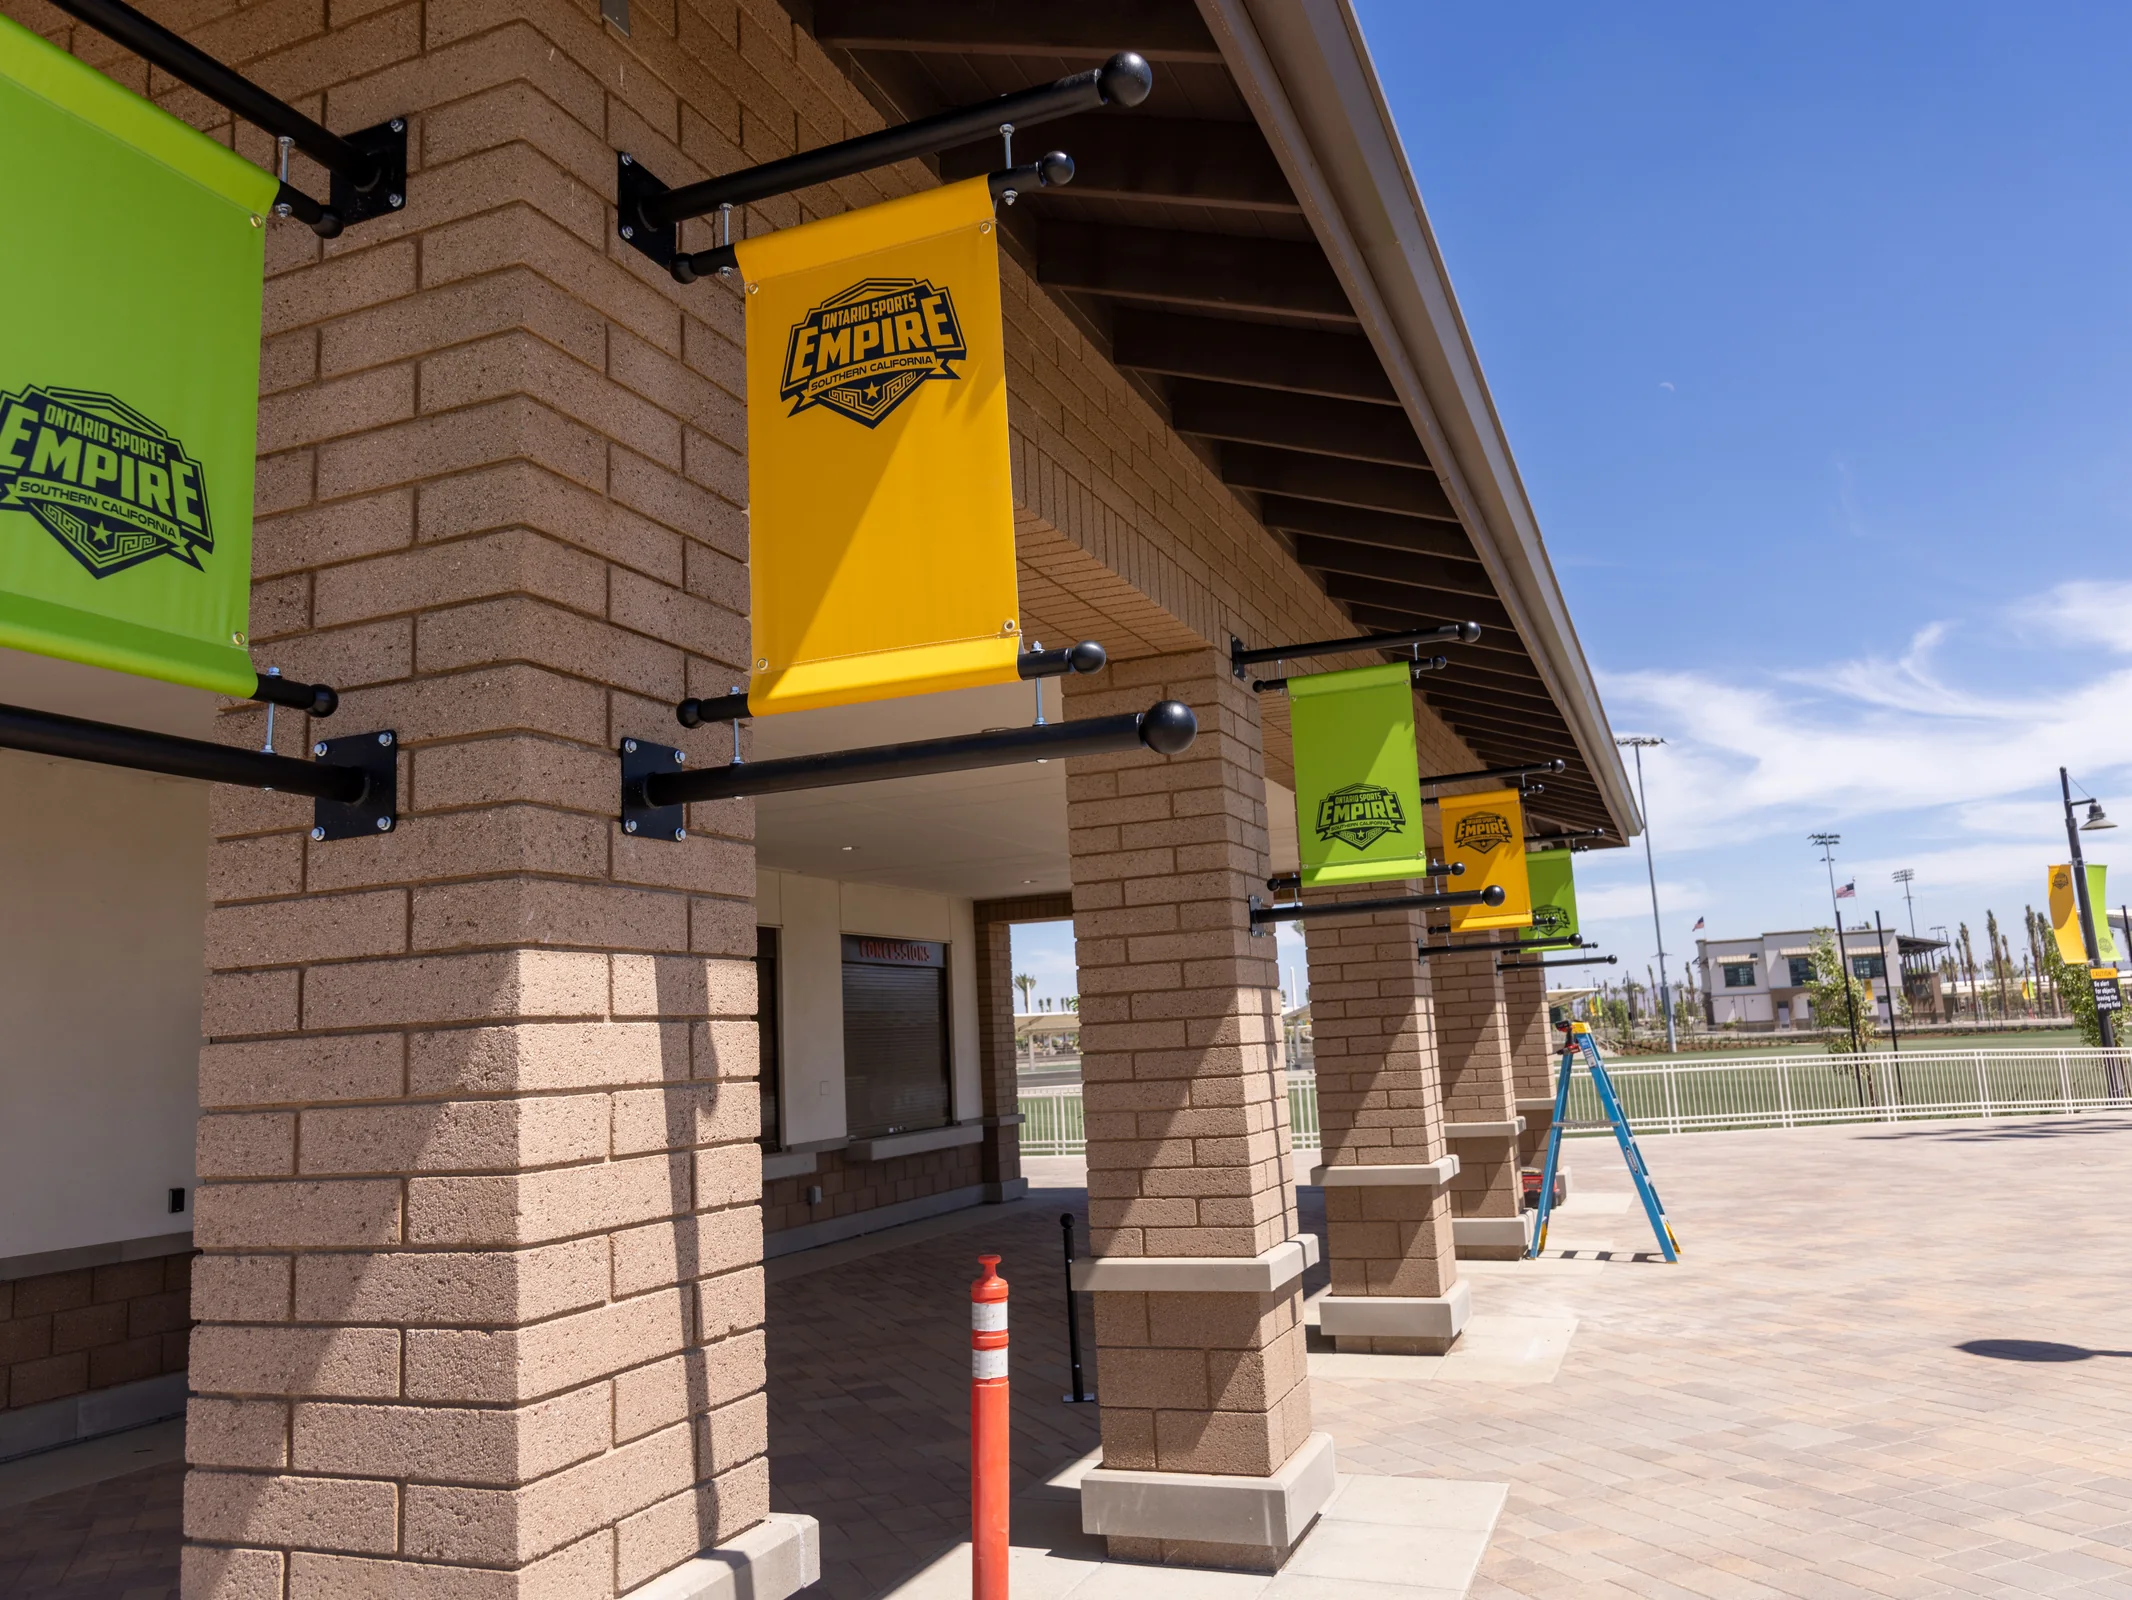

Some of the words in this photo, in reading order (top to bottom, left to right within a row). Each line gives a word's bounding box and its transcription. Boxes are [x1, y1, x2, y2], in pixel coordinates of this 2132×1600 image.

[822, 306, 870, 330] ONTARIO
[871, 292, 917, 318] SPORTS
[789, 294, 955, 383] EMPIRE
[811, 365, 867, 391] SOUTHERN
[870, 356, 933, 372] CALIFORNIA
[44, 403, 109, 444] ONTARIO
[111, 427, 165, 464] SPORTS
[0, 402, 203, 531] EMPIRE
[20, 481, 98, 508] SOUTHERN
[101, 500, 177, 539] CALIFORNIA
[1320, 795, 1400, 826] EMPIRE
[1359, 792, 1381, 801] SPORTS
[1456, 818, 1509, 839] EMPIRE
